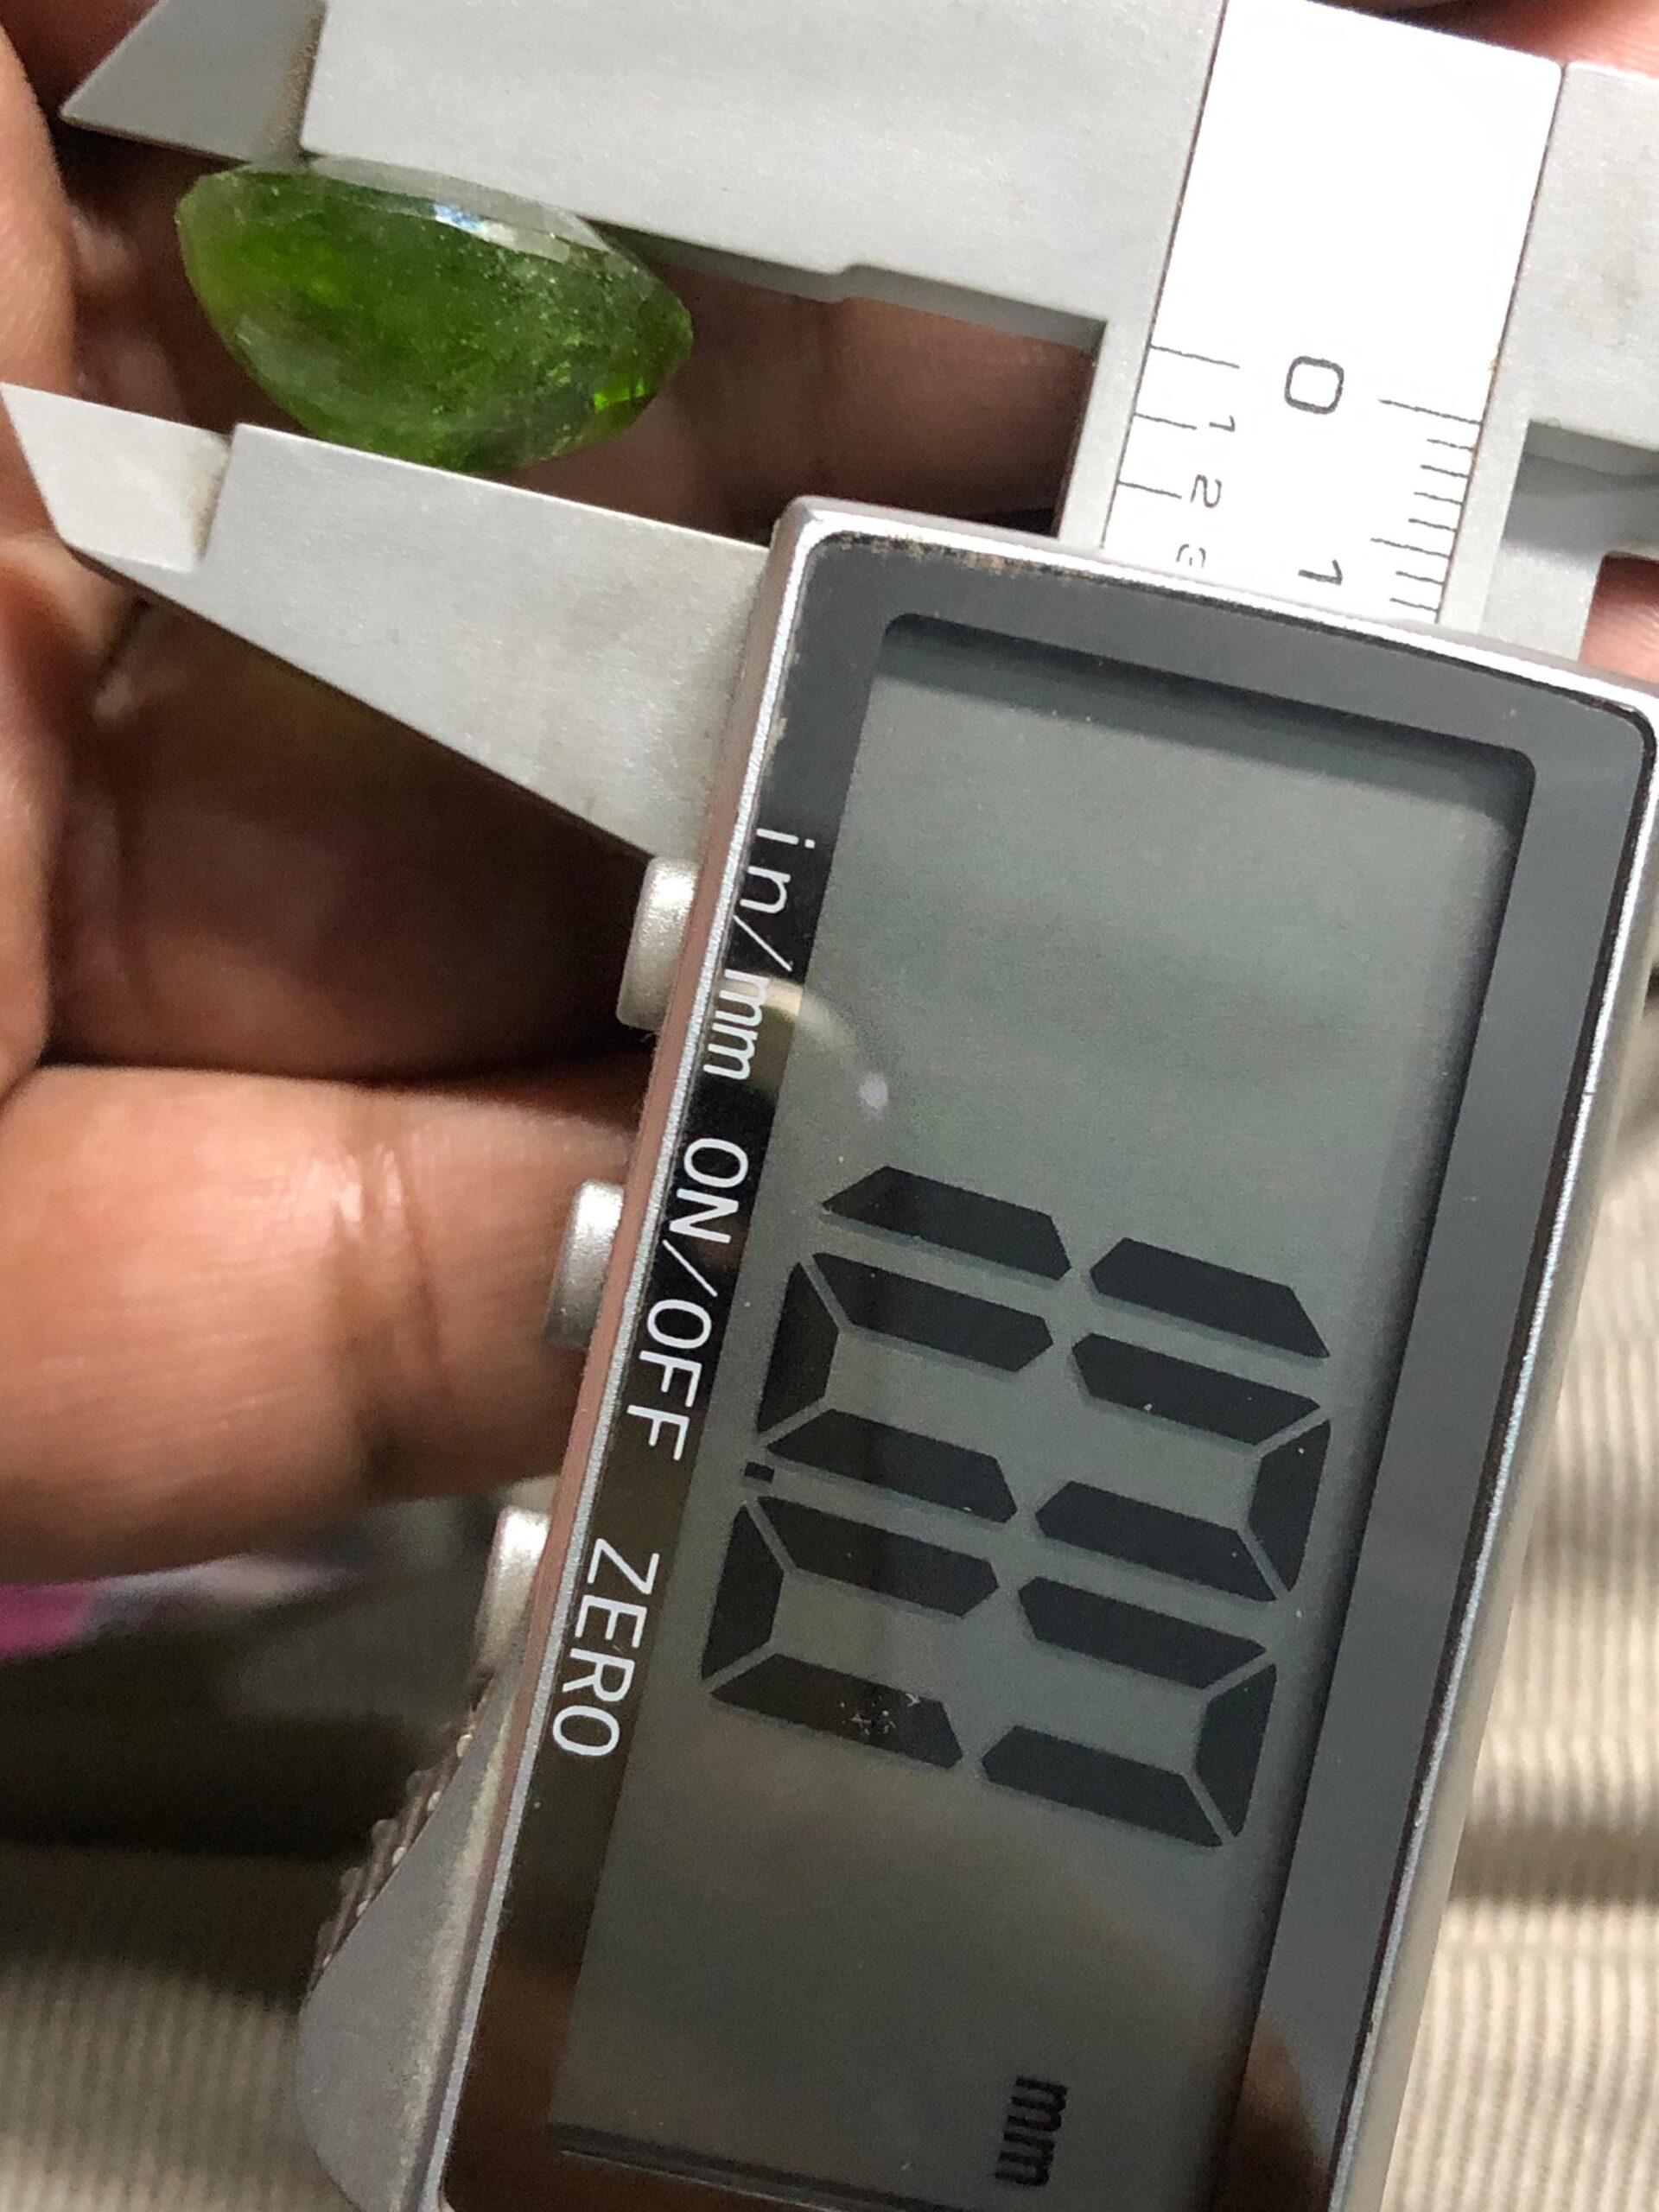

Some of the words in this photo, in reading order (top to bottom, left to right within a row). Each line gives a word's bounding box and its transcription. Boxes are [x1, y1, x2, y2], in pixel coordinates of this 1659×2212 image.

[1209, 416, 1236, 433] 1
[1284, 355, 1344, 415] 0
[1190, 474, 1223, 508] 2
[1298, 559, 1344, 587] 1
[702, 828, 815, 1081] in/mm
[626, 1138, 749, 1460] ON/OFF
[701, 1165, 1332, 1848] 10.0
[552, 1538, 659, 1757] ZERO
[994, 2075, 1069, 2187] mm
